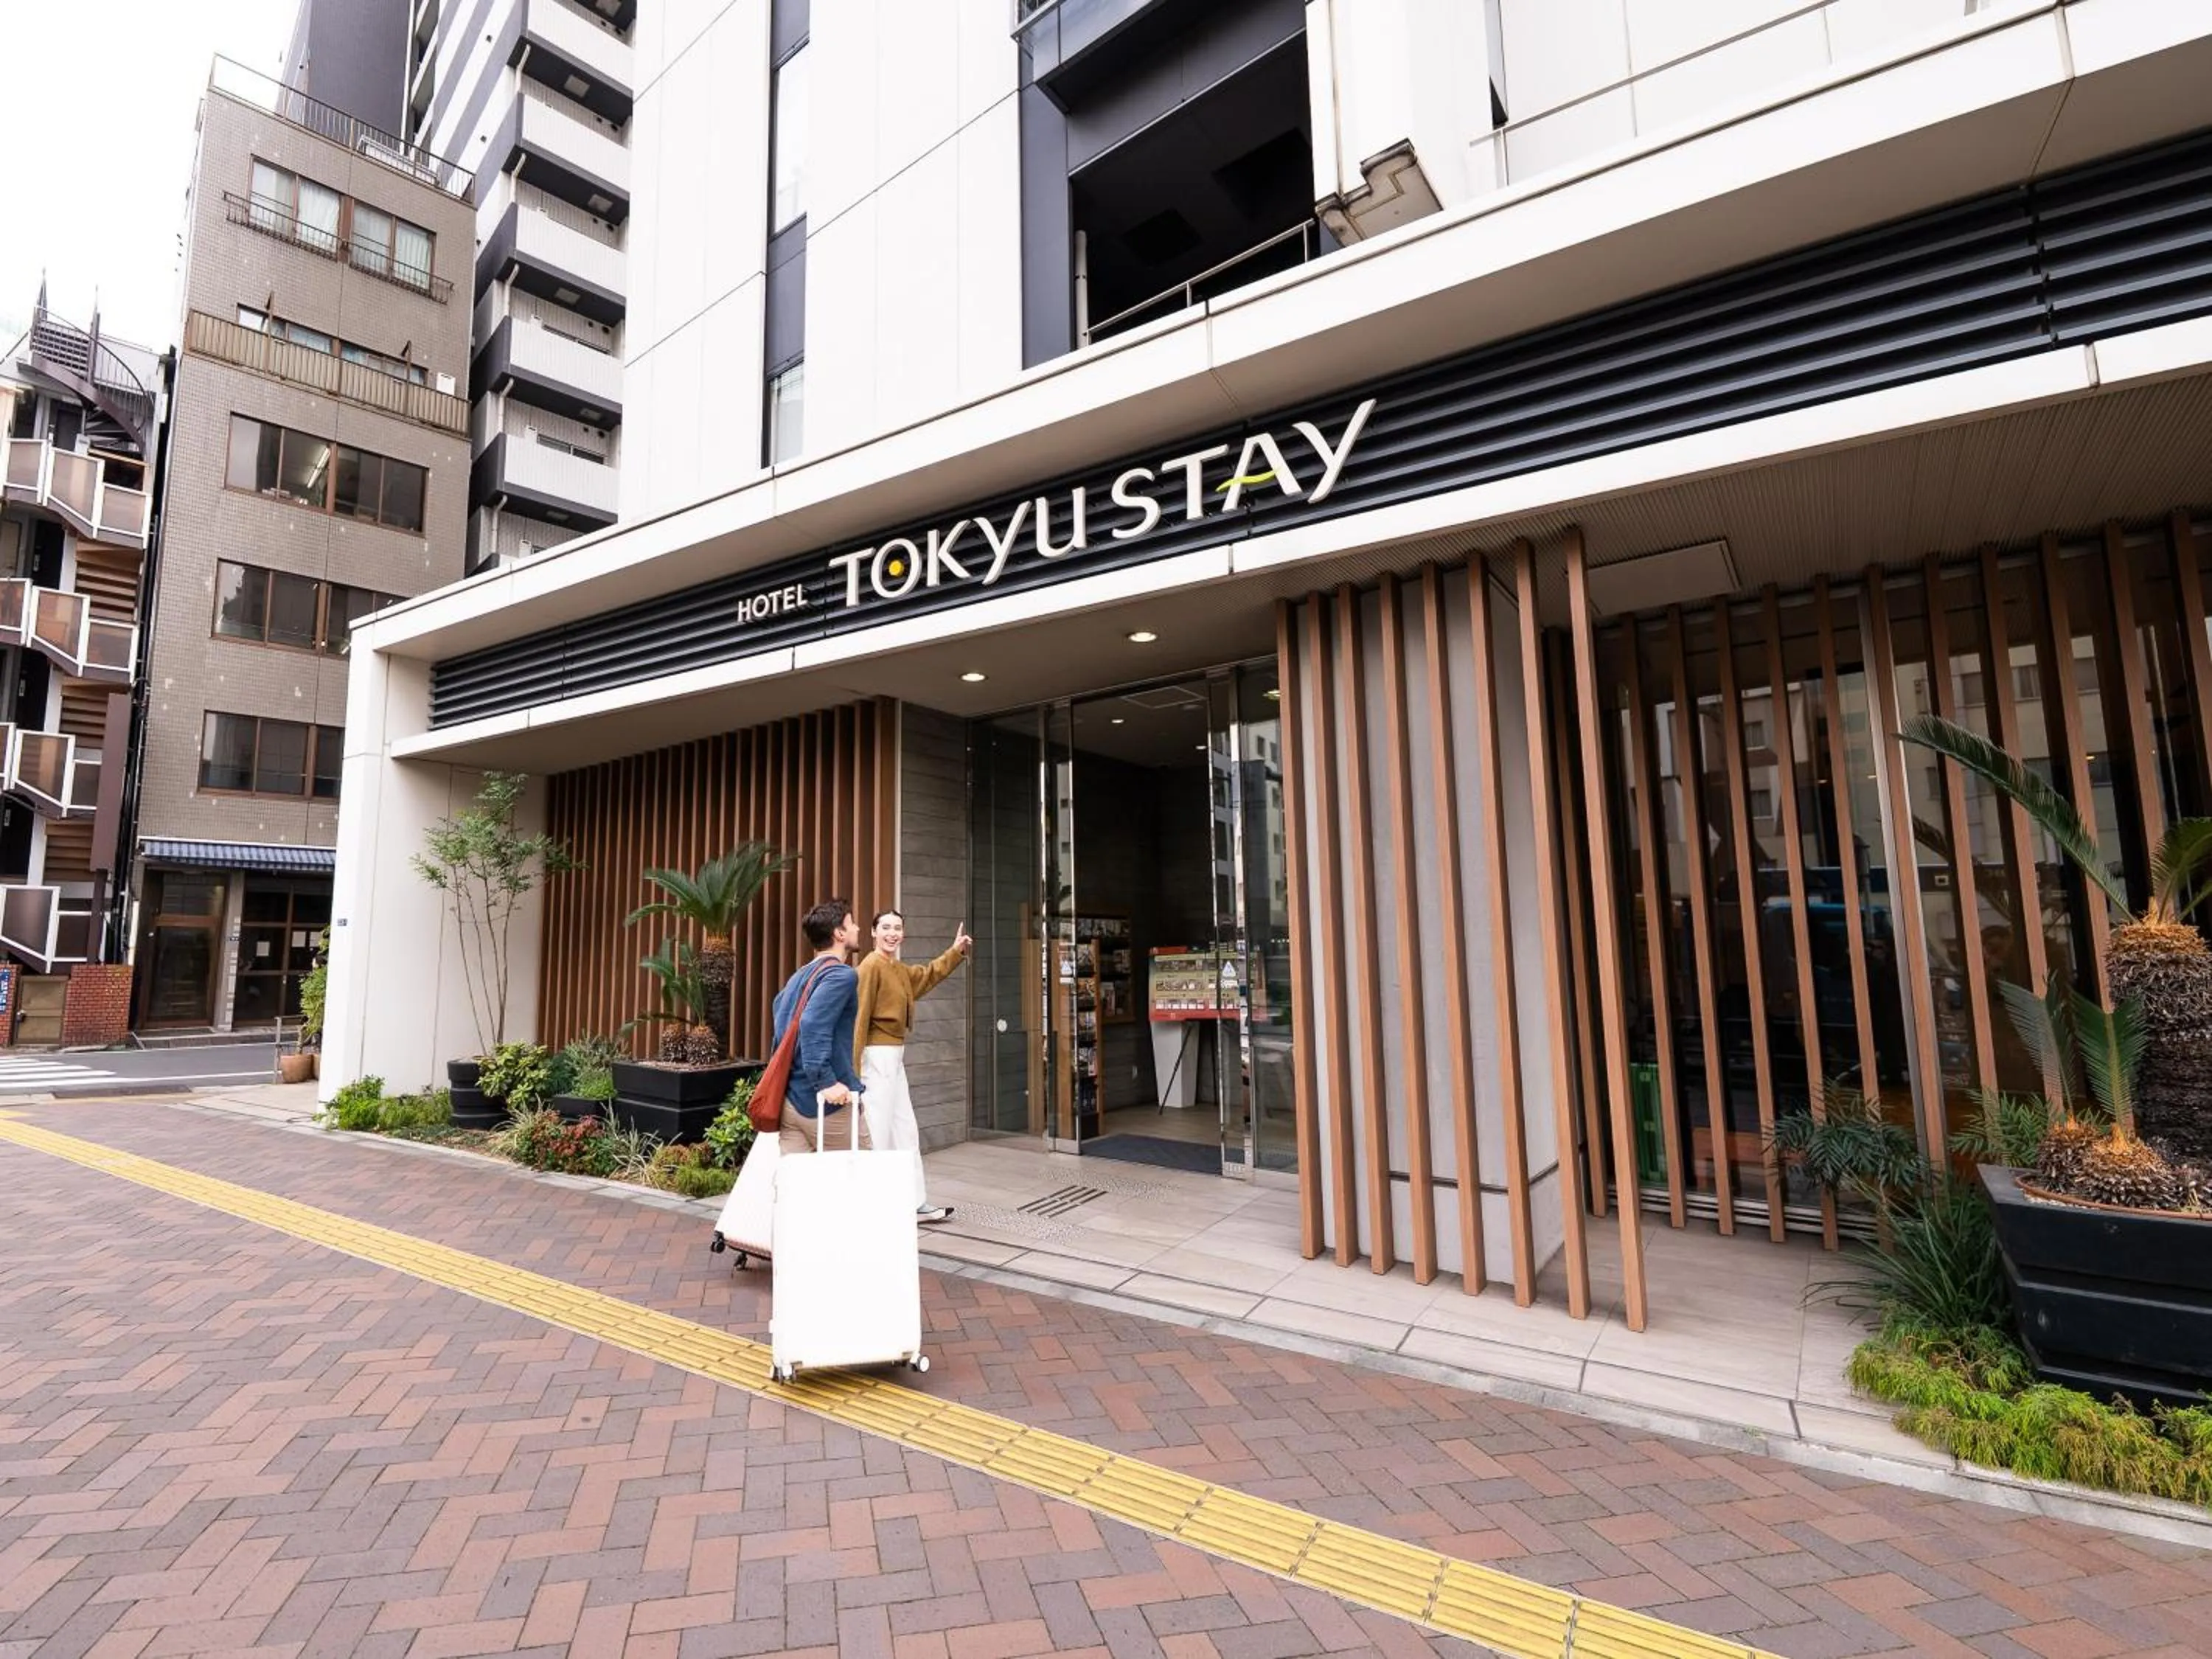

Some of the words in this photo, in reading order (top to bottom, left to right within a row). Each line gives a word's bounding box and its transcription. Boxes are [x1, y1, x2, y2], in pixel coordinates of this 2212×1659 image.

[737, 583, 808, 624] HOTEL
[828, 487, 1087, 608] TOKYU
[1111, 399, 1376, 539] STAY
